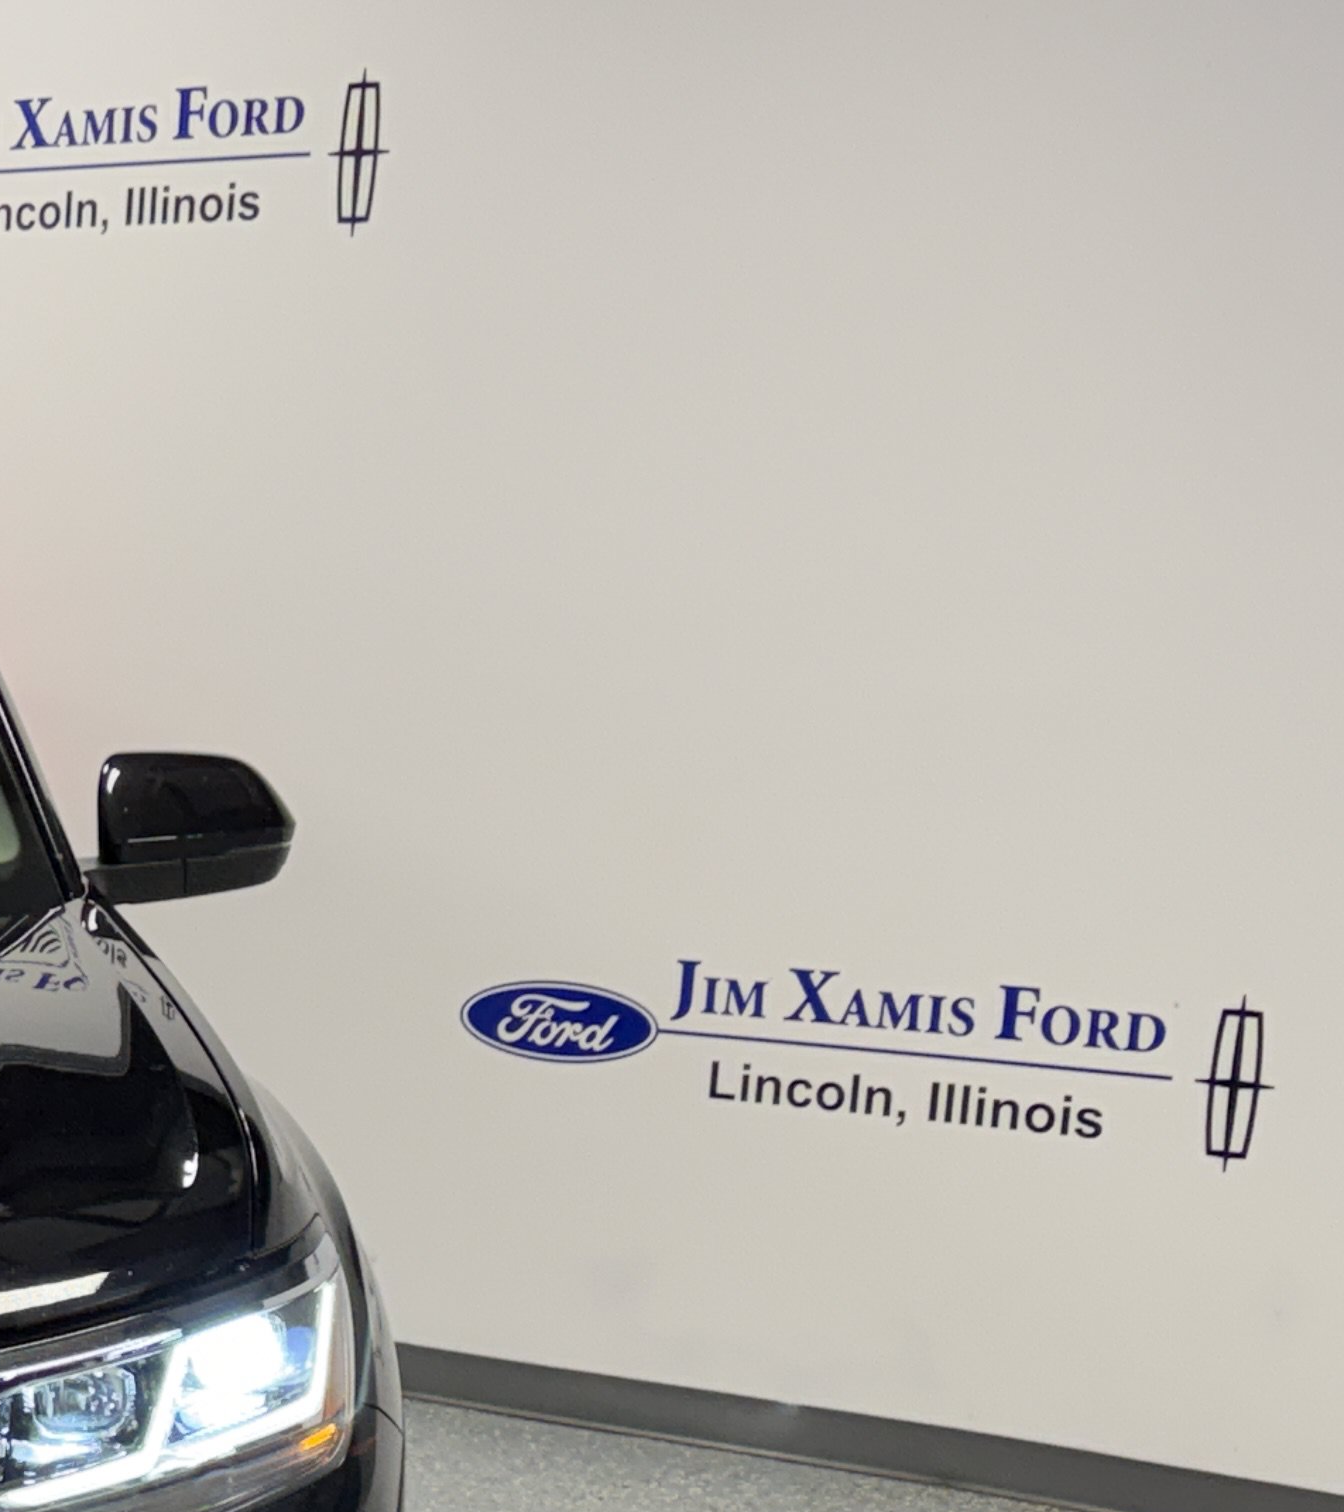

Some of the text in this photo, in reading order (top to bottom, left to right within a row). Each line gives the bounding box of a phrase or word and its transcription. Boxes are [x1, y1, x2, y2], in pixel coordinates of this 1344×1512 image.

[11, 97, 158, 150] XAMIS
[173, 87, 305, 140] FORD
[125, 182, 260, 226] Illinois
[496, 993, 615, 1054] Ford
[670, 959, 1166, 1052] JIM XAMIS FORD
[709, 1061, 1102, 1139] Lincoln, Illinois
